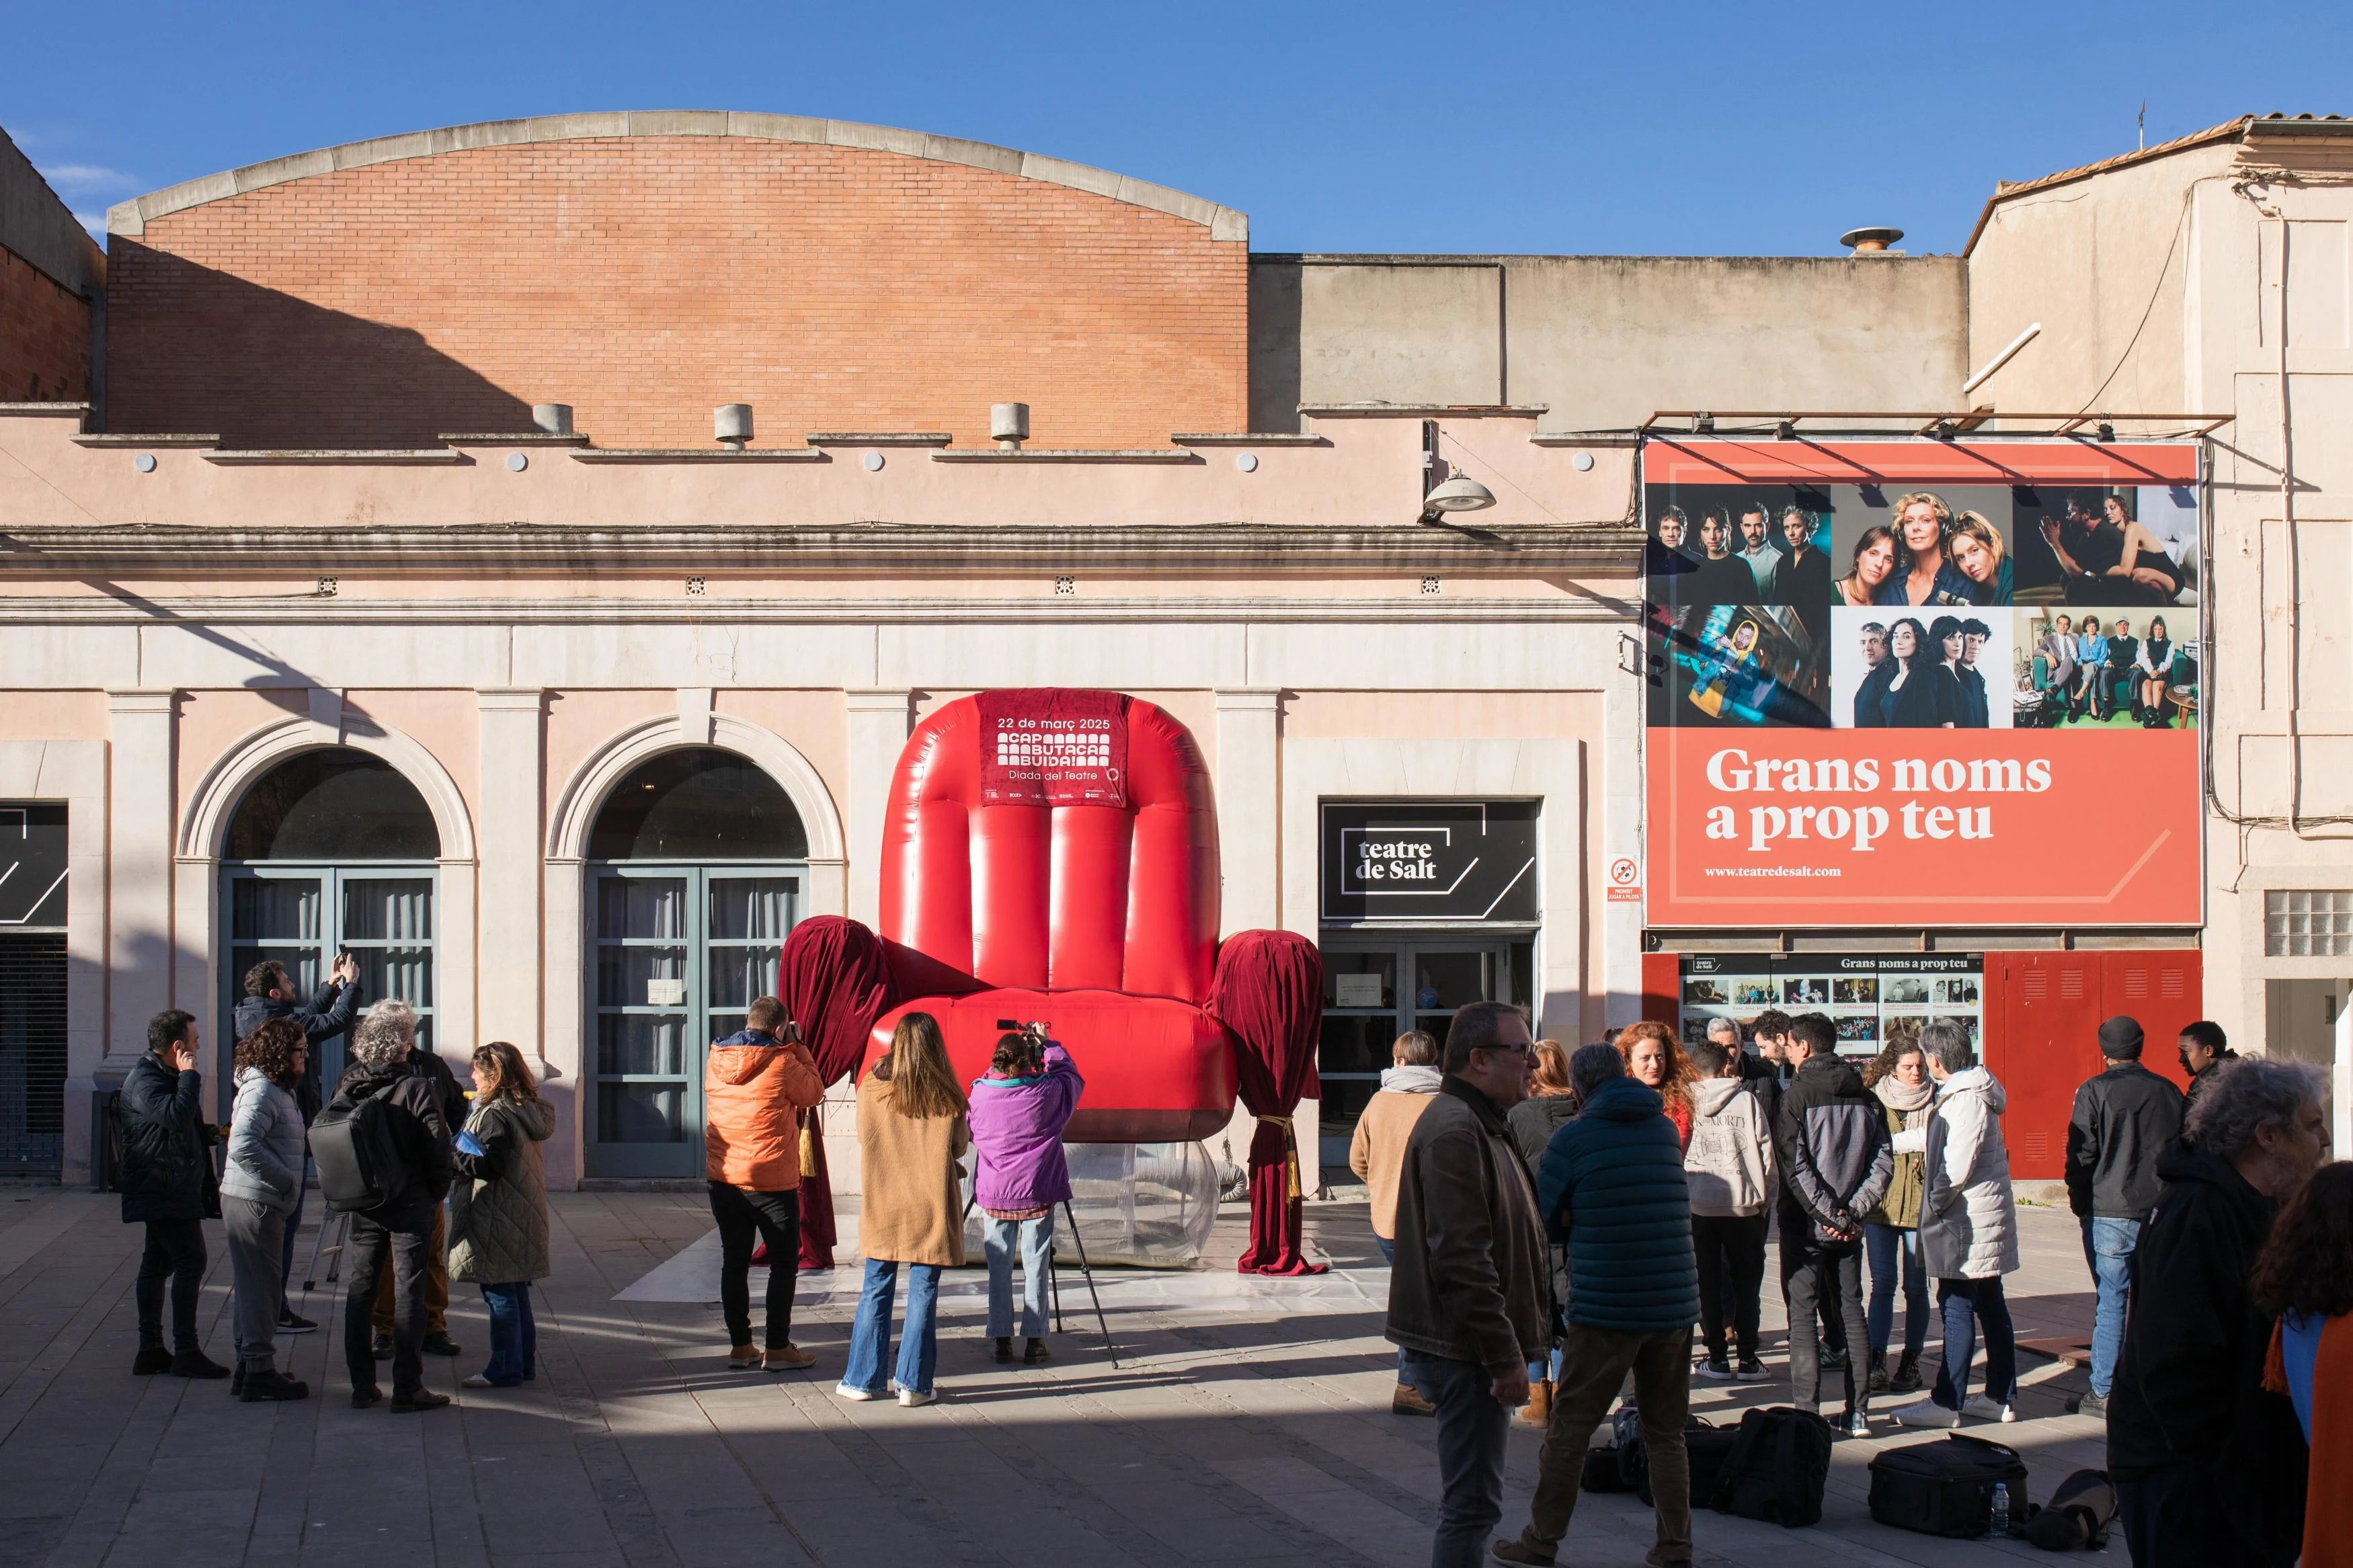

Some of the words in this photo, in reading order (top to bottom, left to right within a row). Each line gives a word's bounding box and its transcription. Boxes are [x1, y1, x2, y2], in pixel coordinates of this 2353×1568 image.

[998, 718, 1014, 728] 22
[1019, 718, 1036, 729] de
[1041, 720, 1075, 731] març
[1080, 718, 1110, 729] 2025
[1008, 733, 1042, 744] CAP
[1032, 744, 1099, 755] BUTACA
[1020, 755, 1076, 767] BUIDA!
[1009, 770, 1041, 780] Diada
[1044, 772, 1061, 780] del
[1064, 771, 1097, 780] Teatre
[1706, 748, 1880, 792] Grans
[1891, 757, 2052, 792] noms
[1705, 805, 1739, 839] a
[1747, 805, 1889, 852] prop
[1899, 799, 1994, 839] teu
[1358, 841, 1432, 858] teatre
[1355, 858, 1385, 879] de
[1389, 858, 1437, 879] Salt
[1704, 866, 1841, 877] www.teatredesalt.com
[1841, 958, 1876, 968] Grans
[1878, 960, 1911, 968] noms
[1912, 960, 1919, 968] a
[1920, 960, 1948, 971] prop
[1949, 959, 1968, 968] teu
[1711, 1115, 1747, 1128] MORTY
